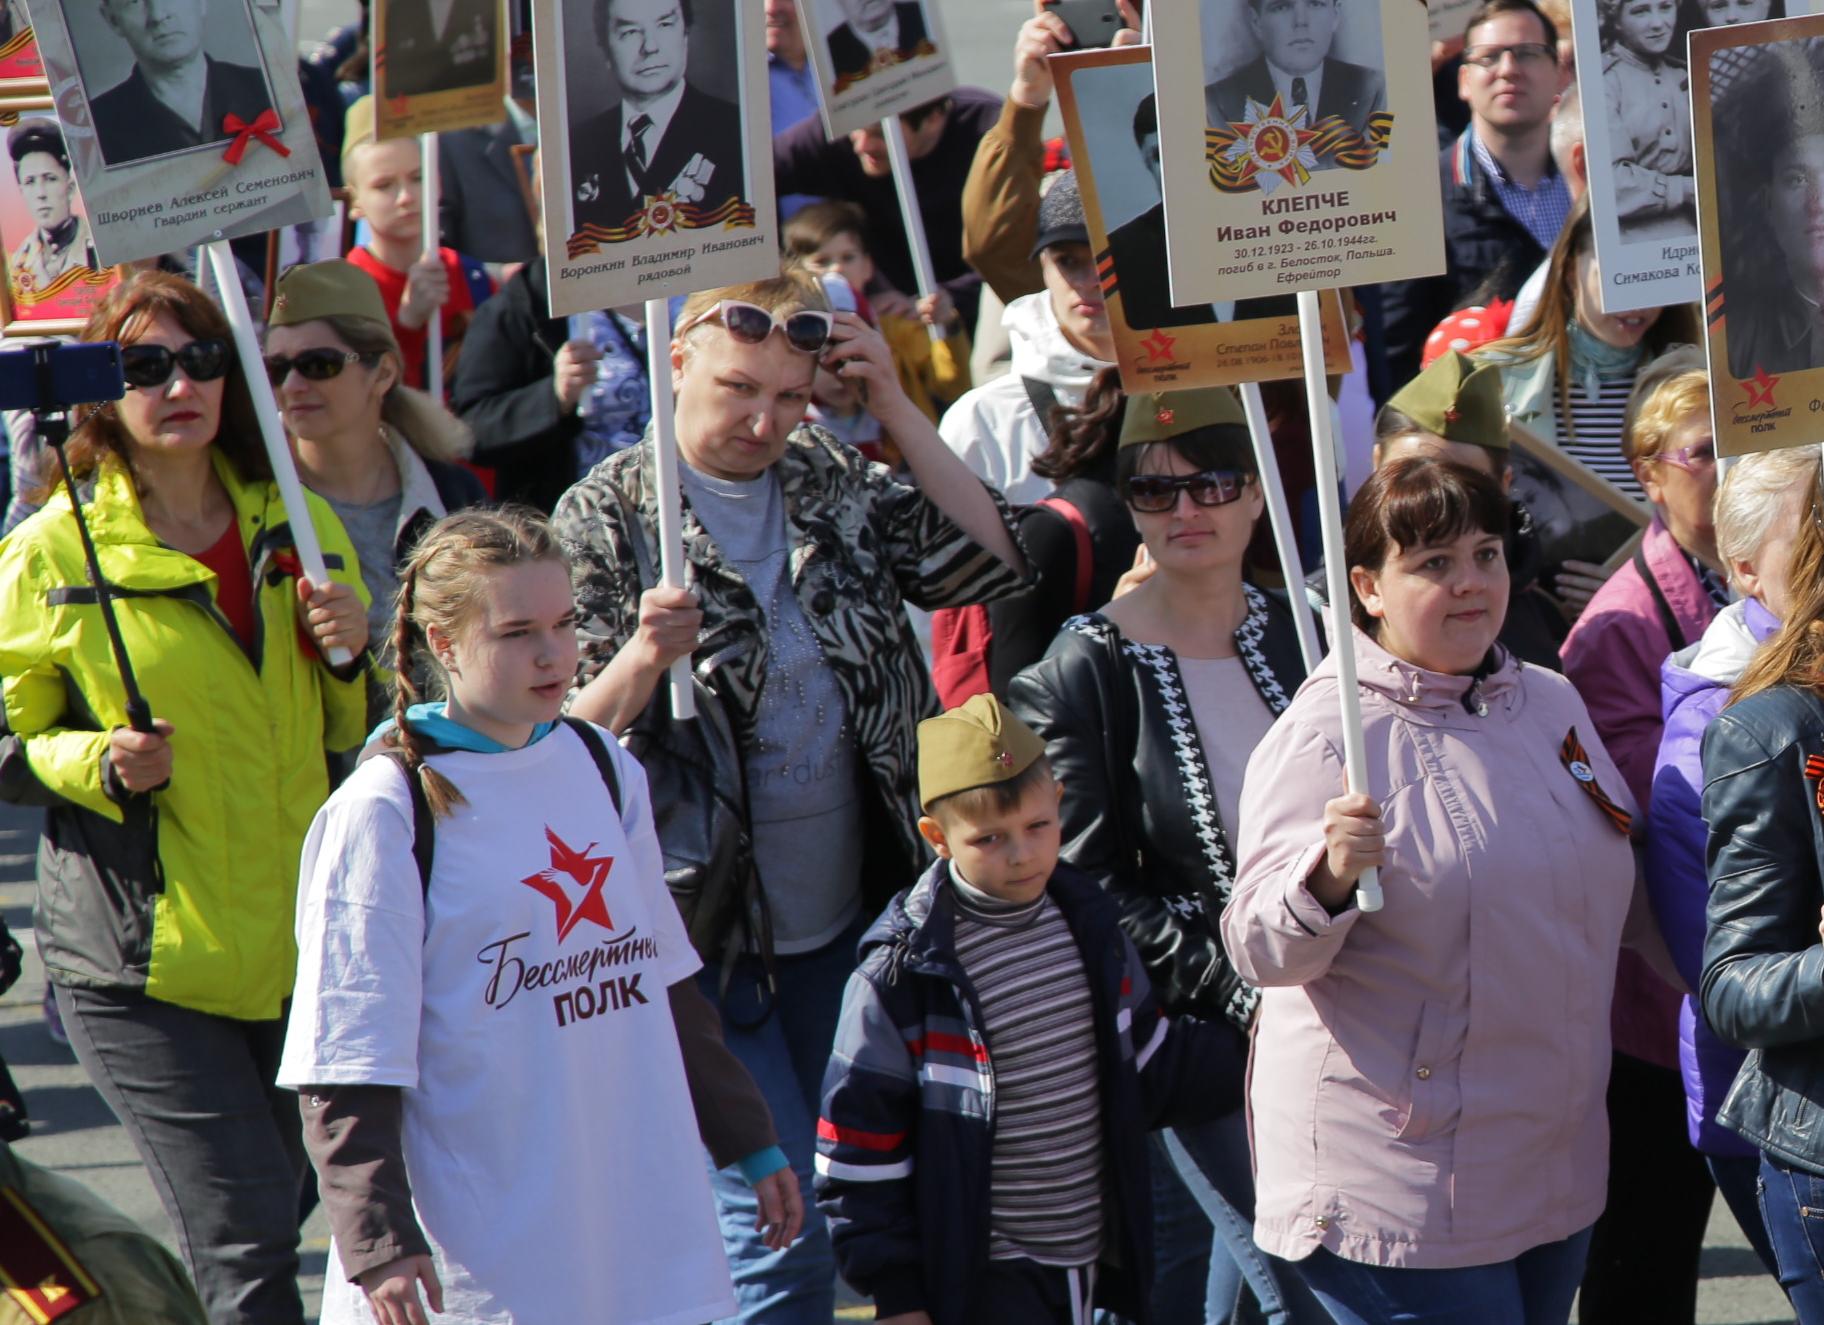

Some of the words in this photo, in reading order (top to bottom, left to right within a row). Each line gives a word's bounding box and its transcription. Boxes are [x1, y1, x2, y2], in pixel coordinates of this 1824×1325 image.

[98, 203, 163, 225] Шворнев
[170, 187, 229, 208] Алексей
[236, 168, 315, 193] Семенович
[154, 209, 207, 228] Гвардии
[213, 195, 268, 216] сержант
[1262, 191, 1350, 215] КЛЕПЧЕ
[1217, 224, 1271, 242] Иван
[1278, 210, 1397, 235] Федорович
[560, 259, 625, 280] Воронкин
[632, 247, 696, 267] Владимир
[701, 234, 764, 254] Иванович
[1218, 260, 1254, 276] погиб
[1257, 262, 1264, 271] в
[1268, 261, 1276, 270] г.
[1281, 250, 1343, 269] Белосток,
[1346, 247, 1396, 261] Польша.
[1234, 243, 1294, 259] 30.12.1923
[637, 264, 691, 285] рядовой
[1277, 268, 1341, 283] Ефрейтор
[1614, 267, 1680, 285] Симакова
[477, 926, 659, 1009] Бессмертны
[553, 973, 650, 1027] ПОЛК
